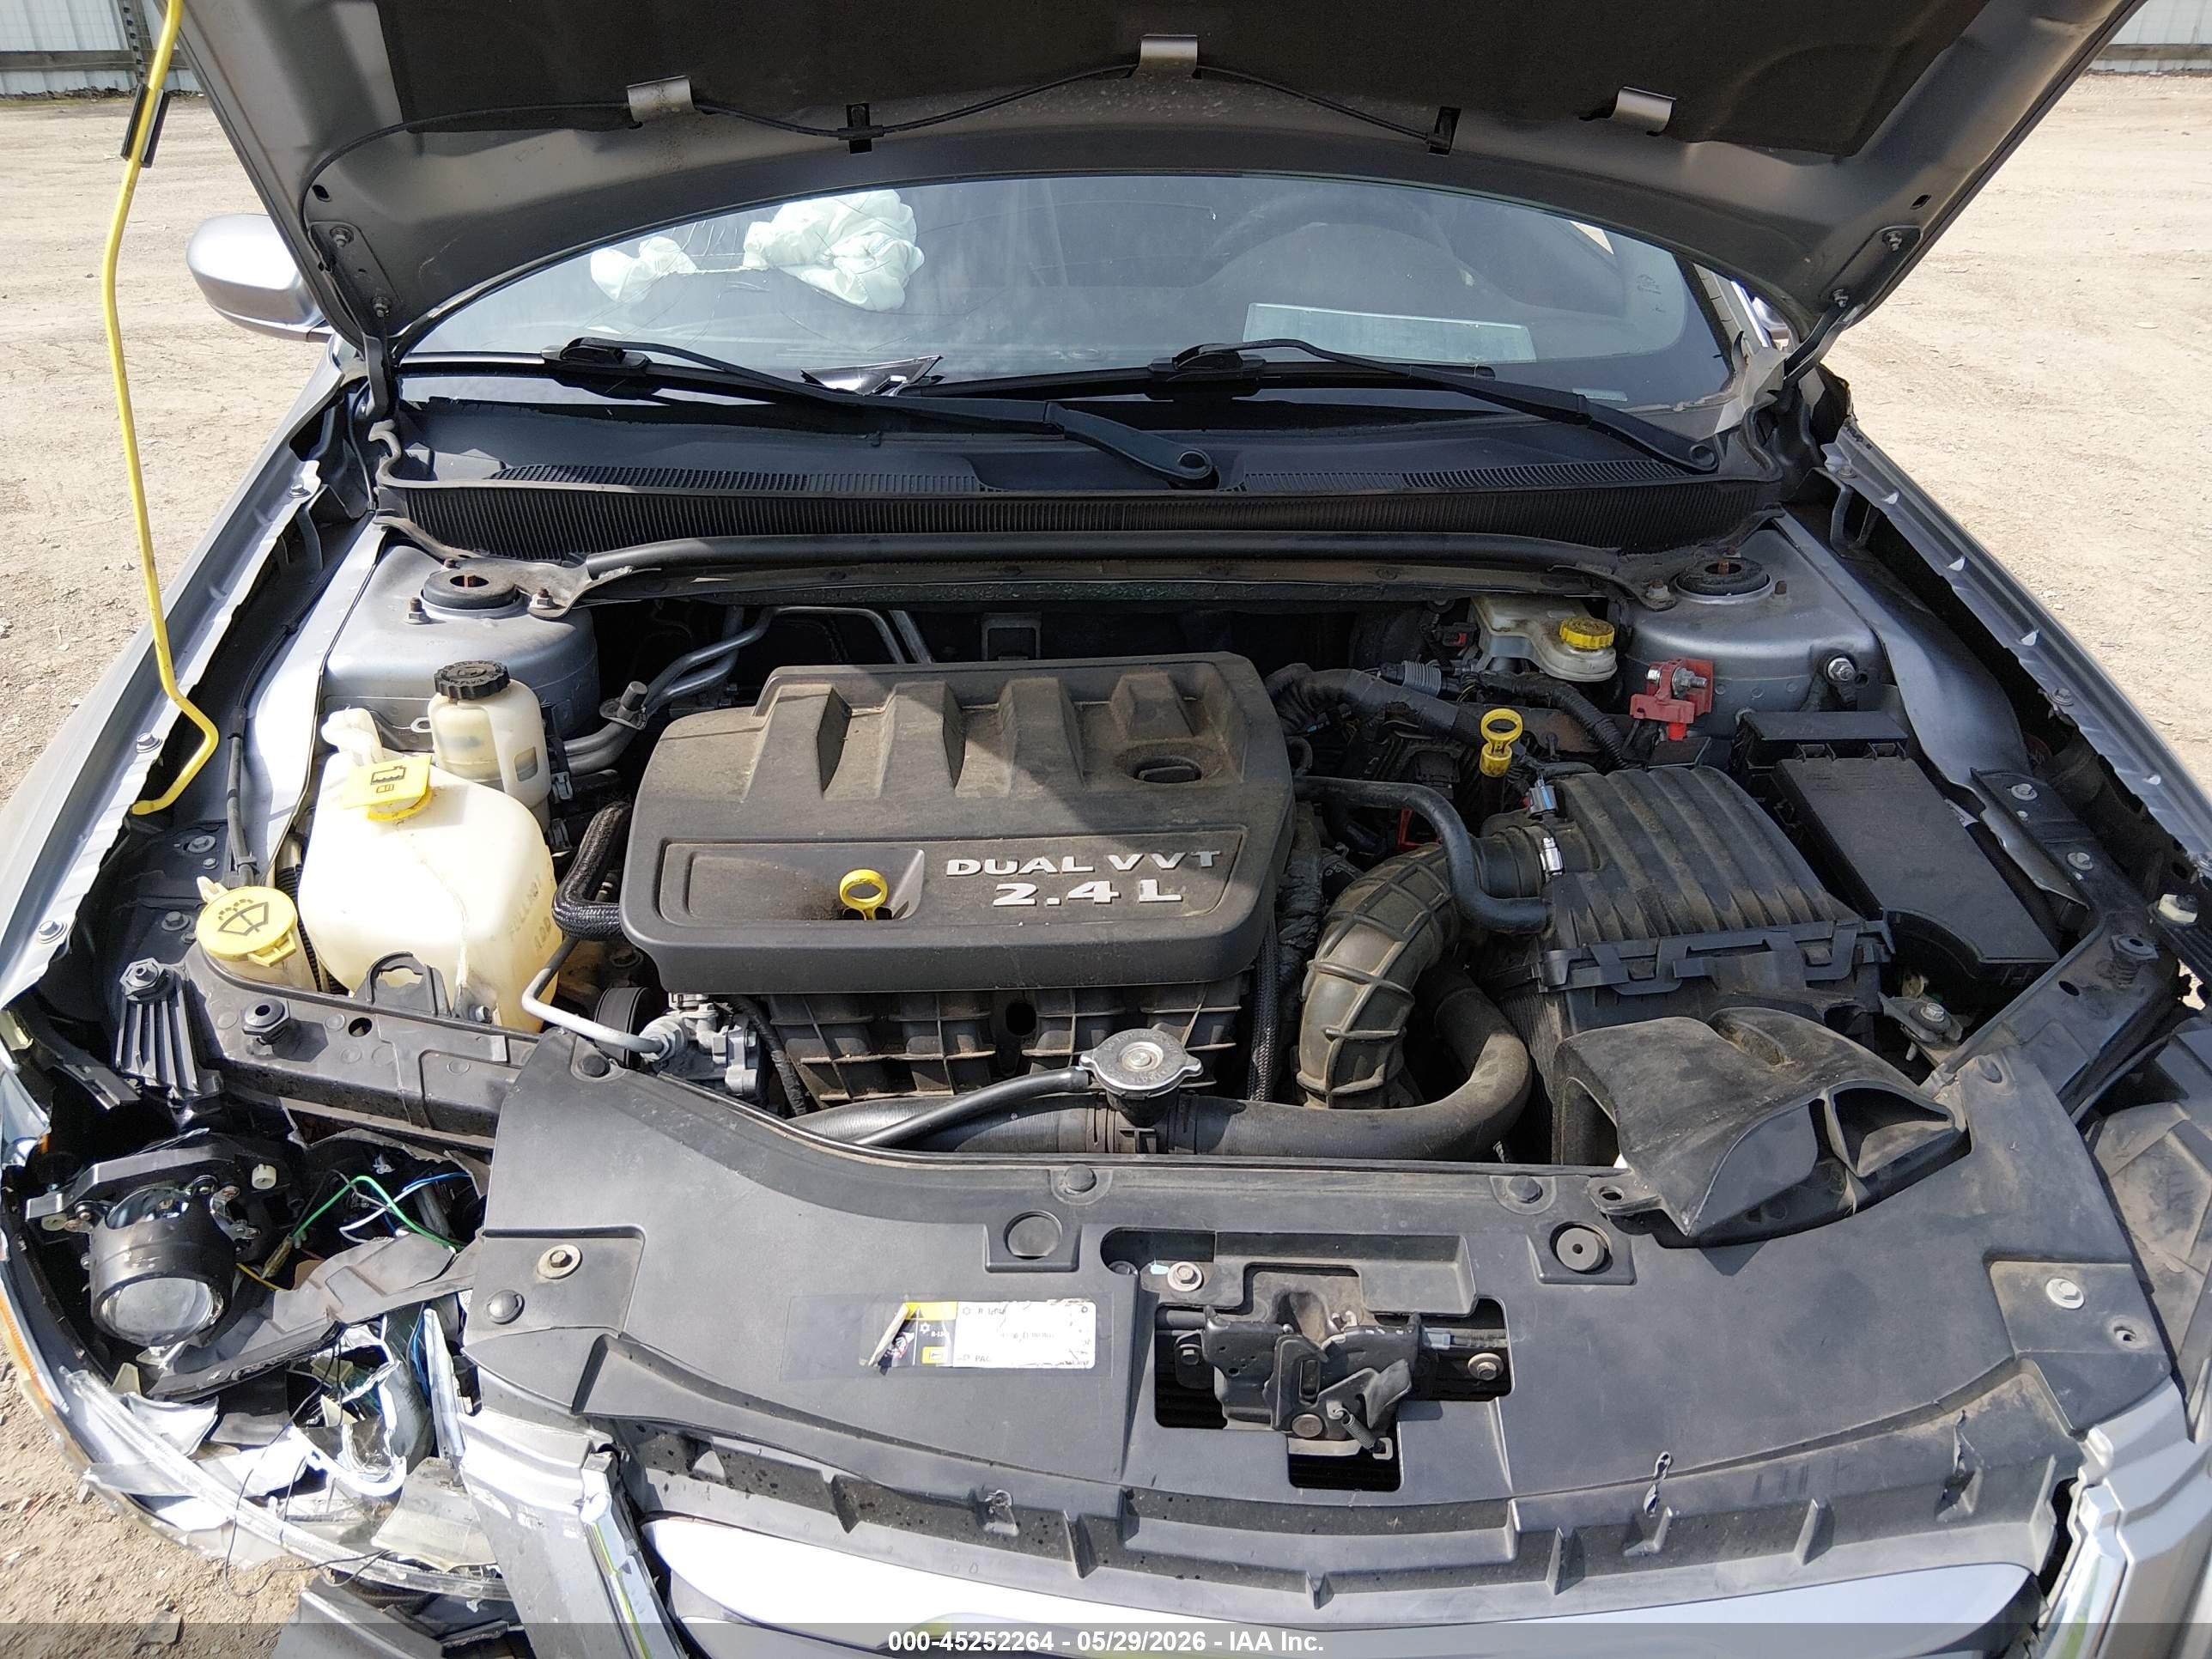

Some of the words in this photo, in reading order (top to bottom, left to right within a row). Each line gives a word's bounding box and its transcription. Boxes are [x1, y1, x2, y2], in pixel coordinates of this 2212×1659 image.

[946, 856, 1095, 877] DUAL
[1108, 850, 1221, 871] VVT
[993, 880, 1121, 907] 2.4
[1139, 878, 1183, 903] L
